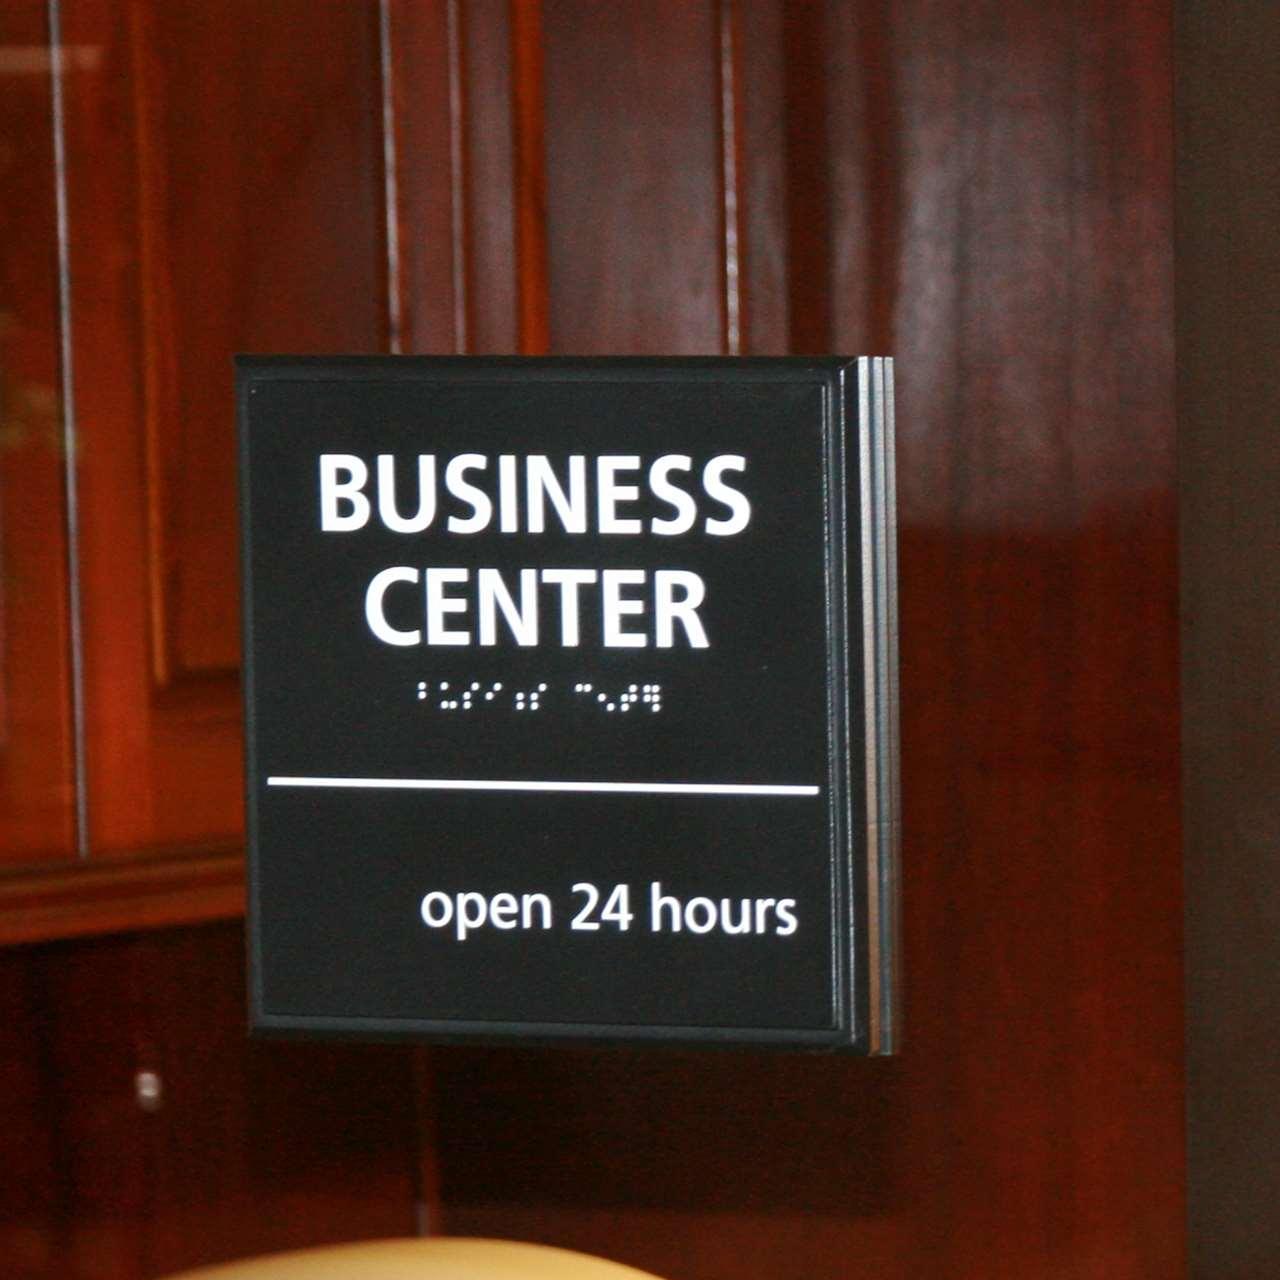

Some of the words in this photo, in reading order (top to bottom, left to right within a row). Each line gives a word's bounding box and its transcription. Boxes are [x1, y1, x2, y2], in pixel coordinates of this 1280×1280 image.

[319, 453, 752, 537] BUSINESS
[364, 566, 710, 649] CENTER
[420, 891, 552, 941] open
[570, 883, 634, 932] 24
[650, 881, 798, 936] hours
